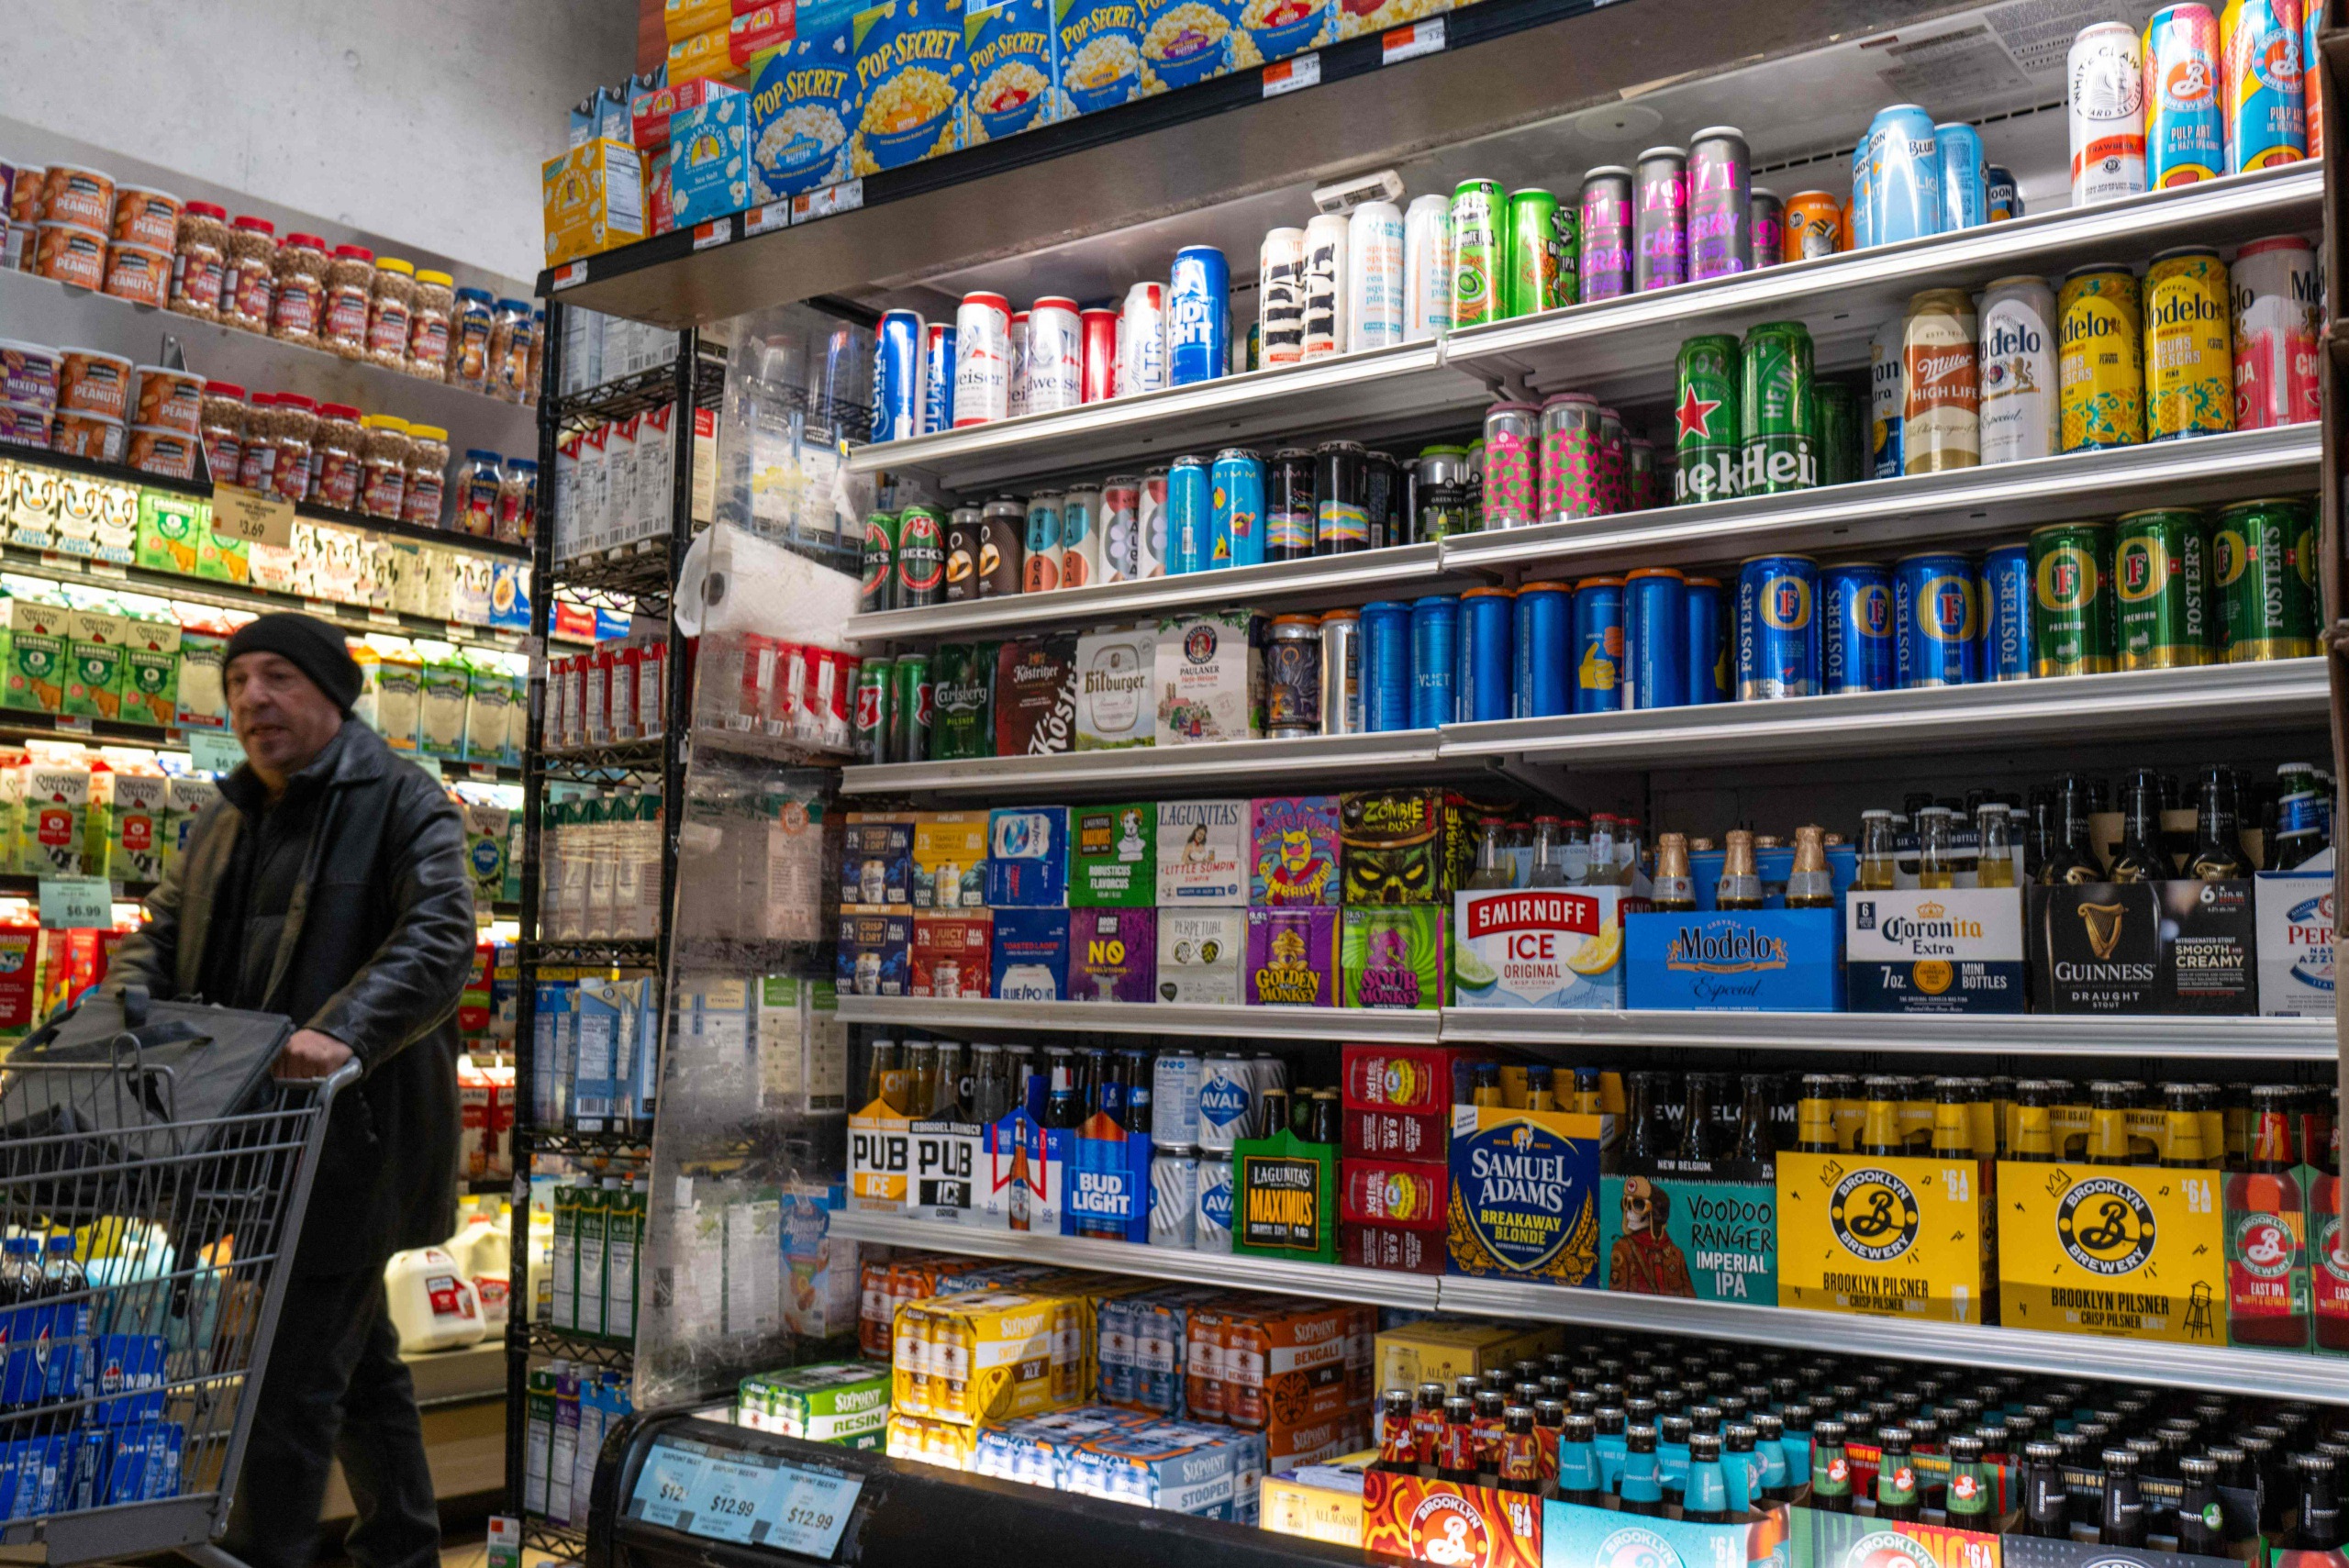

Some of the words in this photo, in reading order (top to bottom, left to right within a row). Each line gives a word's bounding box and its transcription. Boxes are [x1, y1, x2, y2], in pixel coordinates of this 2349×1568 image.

[2270, 106, 2290, 120] PULP
[2171, 126, 2192, 140] PULP
[2196, 125, 2210, 139] ART
[56, 197, 104, 220] PEANUTS
[1917, 353, 1974, 384] Miller
[73, 386, 121, 406] PEANUTS
[1913, 389, 1947, 401] HIGH
[1952, 384, 1978, 398] LIFE
[899, 547, 944, 562] BECK'S
[2186, 534, 2202, 638] FOSTER'S
[2264, 525, 2282, 628] FOSTER'S
[2000, 569, 2018, 663] FOSTER'S
[2122, 609, 2157, 624] PREMIUM
[1741, 581, 1753, 673] FOSTER'S
[1828, 587, 1843, 679] FOSTER'S
[1898, 581, 1909, 673] FOSTER'S
[1013, 663, 1059, 684] Köstritzer
[1180, 666, 1219, 676] PAULANER
[1181, 674, 1218, 684] Hefe-Weizen
[1085, 672, 1145, 695] Bitburger
[934, 680, 987, 714] Carlsberg
[946, 716, 975, 726] PILSNER
[1159, 802, 1239, 826] LAGUNITAS
[1364, 799, 1423, 823] ZOMBIE
[865, 831, 885, 840] CRISP
[1387, 819, 1417, 832] DUST
[848, 831, 859, 843] 5%
[1088, 865, 1131, 876] ROBUSTICUS
[1165, 862, 1198, 875] LITTLE
[1090, 878, 1130, 889] FLAVORCUS
[2200, 885, 2215, 904] 6
[1478, 899, 1587, 929] SMIRNOFF
[842, 922, 854, 934] 5%
[860, 923, 883, 931] CRISP
[866, 932, 881, 941] DRY
[887, 931, 904, 940] FRUIT
[936, 928, 963, 939] JUICY
[968, 929, 982, 938] REAL
[1174, 919, 1222, 935] PERPETUAL
[1882, 917, 1983, 945] Coronita
[1088, 940, 1125, 964] NO
[1508, 933, 1555, 960] ICE
[1678, 927, 1773, 960] Modelo
[1912, 939, 1954, 955] Extra
[2175, 945, 2229, 956] SMOOTH
[1504, 964, 1562, 979] ORIGINAL
[1962, 962, 1986, 977] MINI
[2054, 962, 2154, 982] GUINNESS
[2175, 955, 2243, 969] CREAMY
[1255, 968, 1321, 989] GOLDEN
[1362, 969, 1419, 990] SOUR
[1692, 974, 1761, 998] Especial
[1962, 975, 2008, 990] BOTTLES
[1258, 986, 1318, 1003] MONKEY
[1359, 986, 1421, 1005] MONKEY
[2072, 991, 2141, 1003] DRAUGHT
[1201, 1090, 1244, 1109] AVAL
[2069, 1111, 2078, 1121] US
[1388, 1118, 1398, 1149] 6.8%
[853, 1134, 908, 1171] PUB
[918, 1140, 973, 1178] PUB
[1253, 1165, 1311, 1184] LAGUNITAS
[1470, 1147, 1574, 1188] SAMUEL
[1657, 1160, 1675, 1171] NEW
[864, 1176, 890, 1198] ICE
[936, 1181, 960, 1205] ICE
[1079, 1173, 1122, 1194] BUD
[1837, 1171, 1909, 1201] BROOKLYN
[1073, 1190, 1130, 1215] LIGHT
[1478, 1179, 1564, 1215] ADAMS
[2065, 1180, 2145, 1212] BROOKLYN
[1250, 1188, 1313, 1226] MAXIMUS
[1687, 1194, 1773, 1223] VOODOO
[1480, 1210, 1562, 1232] BREAKAWAY
[2241, 1217, 2289, 1235] BROOKLYN
[1495, 1227, 1546, 1246] BLONDE
[1691, 1222, 1774, 1253] RANGER
[1840, 1229, 1909, 1262] BREWERY
[1387, 1233, 1398, 1264] 6.8%
[2068, 1241, 2146, 1275] BREWERY
[1696, 1251, 1769, 1274] IMPERIAL
[2243, 1257, 2290, 1275] BREWERY
[1714, 1272, 1748, 1298] IPA
[1822, 1272, 1879, 1294] BROOKLYN
[1882, 1275, 1929, 1299] PILSNER
[2251, 1283, 2270, 1296] EAST
[2272, 1284, 2285, 1296] IPA
[1849, 1295, 1870, 1308] CRISP
[1871, 1296, 1904, 1311] PILSNER
[2051, 1287, 2114, 1311] BROOKLYN
[2118, 1291, 2169, 1316] PILSNER
[2080, 1310, 2105, 1326] CRISP
[2107, 1314, 2141, 1329] PILSNER
[1294, 1347, 1340, 1365] BENGALI
[834, 1388, 881, 1412] SIXPOINT
[832, 1413, 882, 1434] RESIN
[817, 1478, 838, 1490] BEERS
[710, 1496, 755, 1517] $12.99
[1181, 1485, 1230, 1507] STOOPER
[787, 1507, 833, 1530] $12.99
[1314, 1509, 1356, 1527] ALLAGASH
[1417, 1496, 1481, 1531] BROOKLYN
[1606, 1529, 1675, 1565] BROOKLYN
